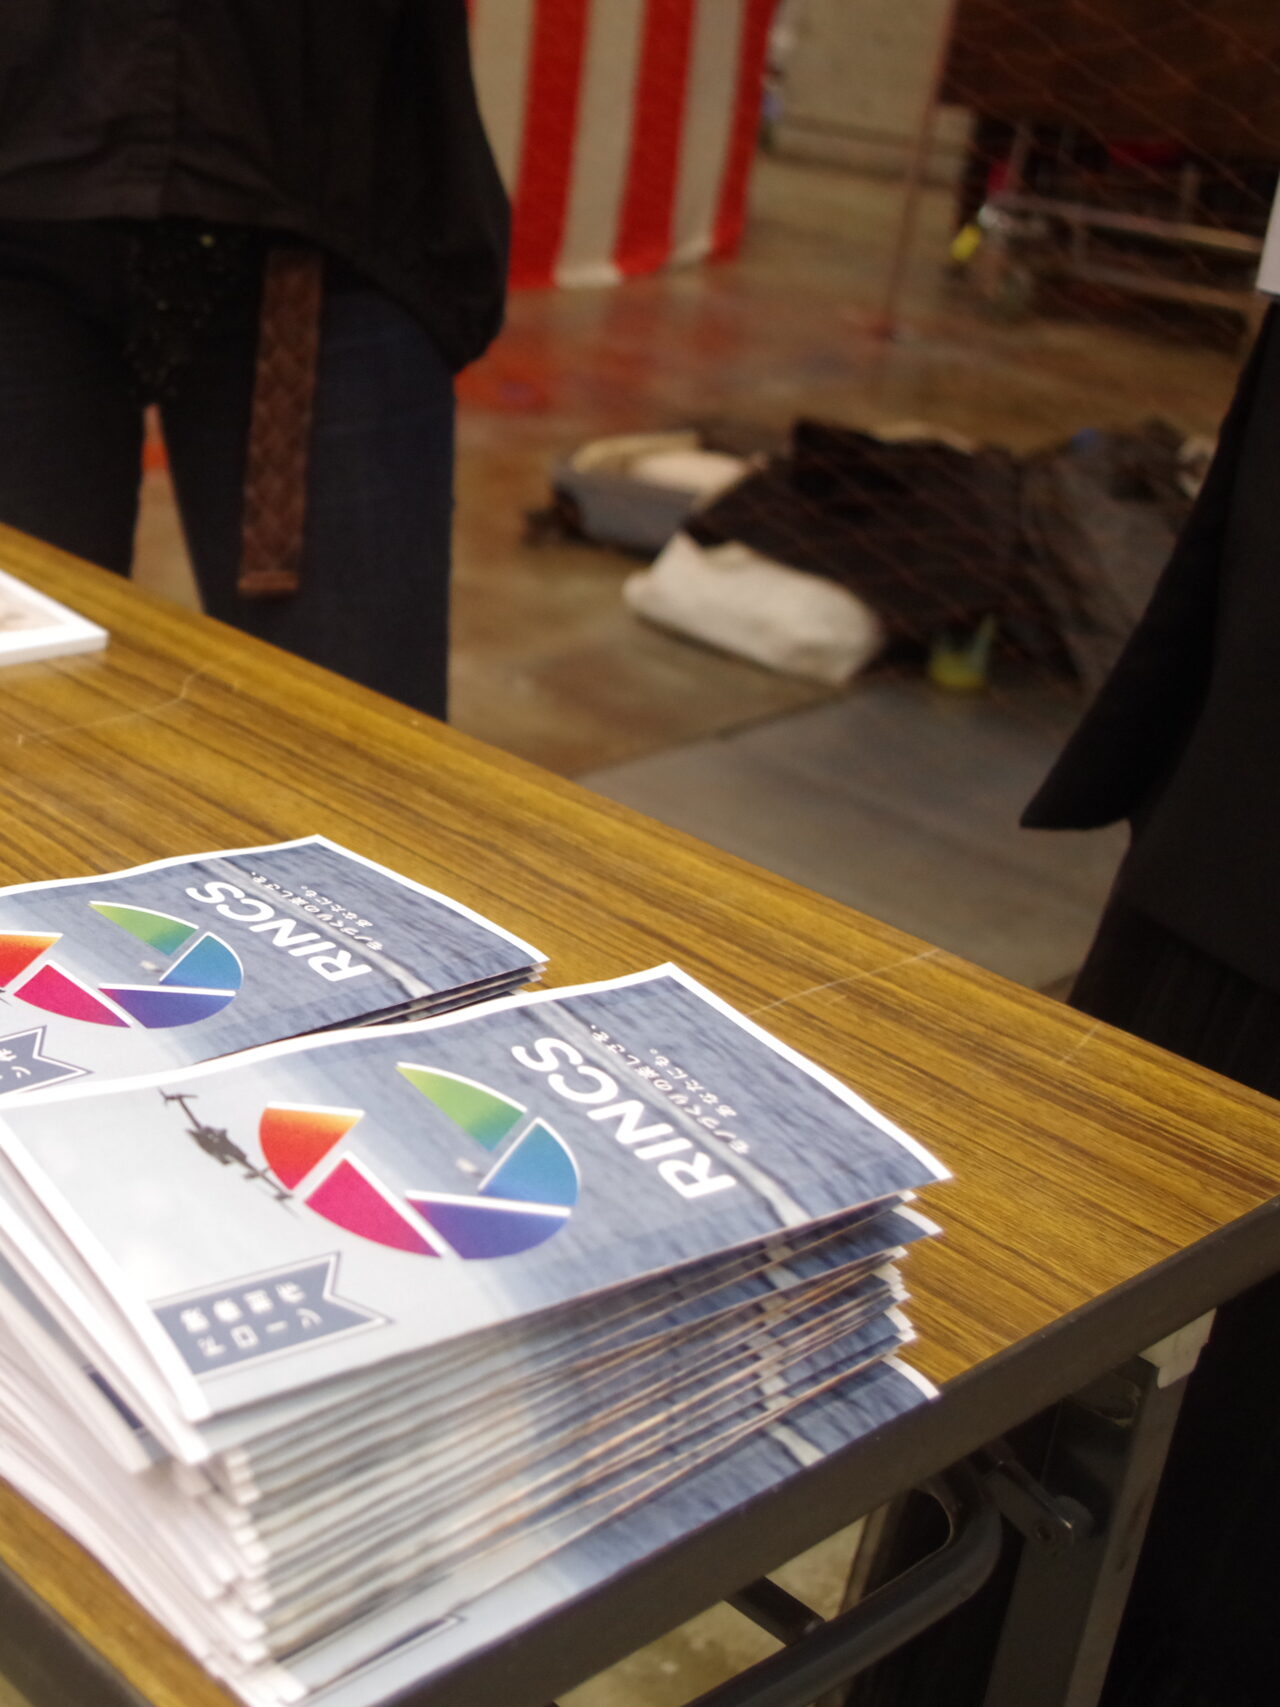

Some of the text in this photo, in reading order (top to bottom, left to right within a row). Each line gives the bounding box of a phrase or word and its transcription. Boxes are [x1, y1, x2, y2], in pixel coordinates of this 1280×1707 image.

[184, 880, 373, 982] RINCS
[510, 1036, 738, 1199] RINCS
[196, 1307, 324, 1359] ドローン
